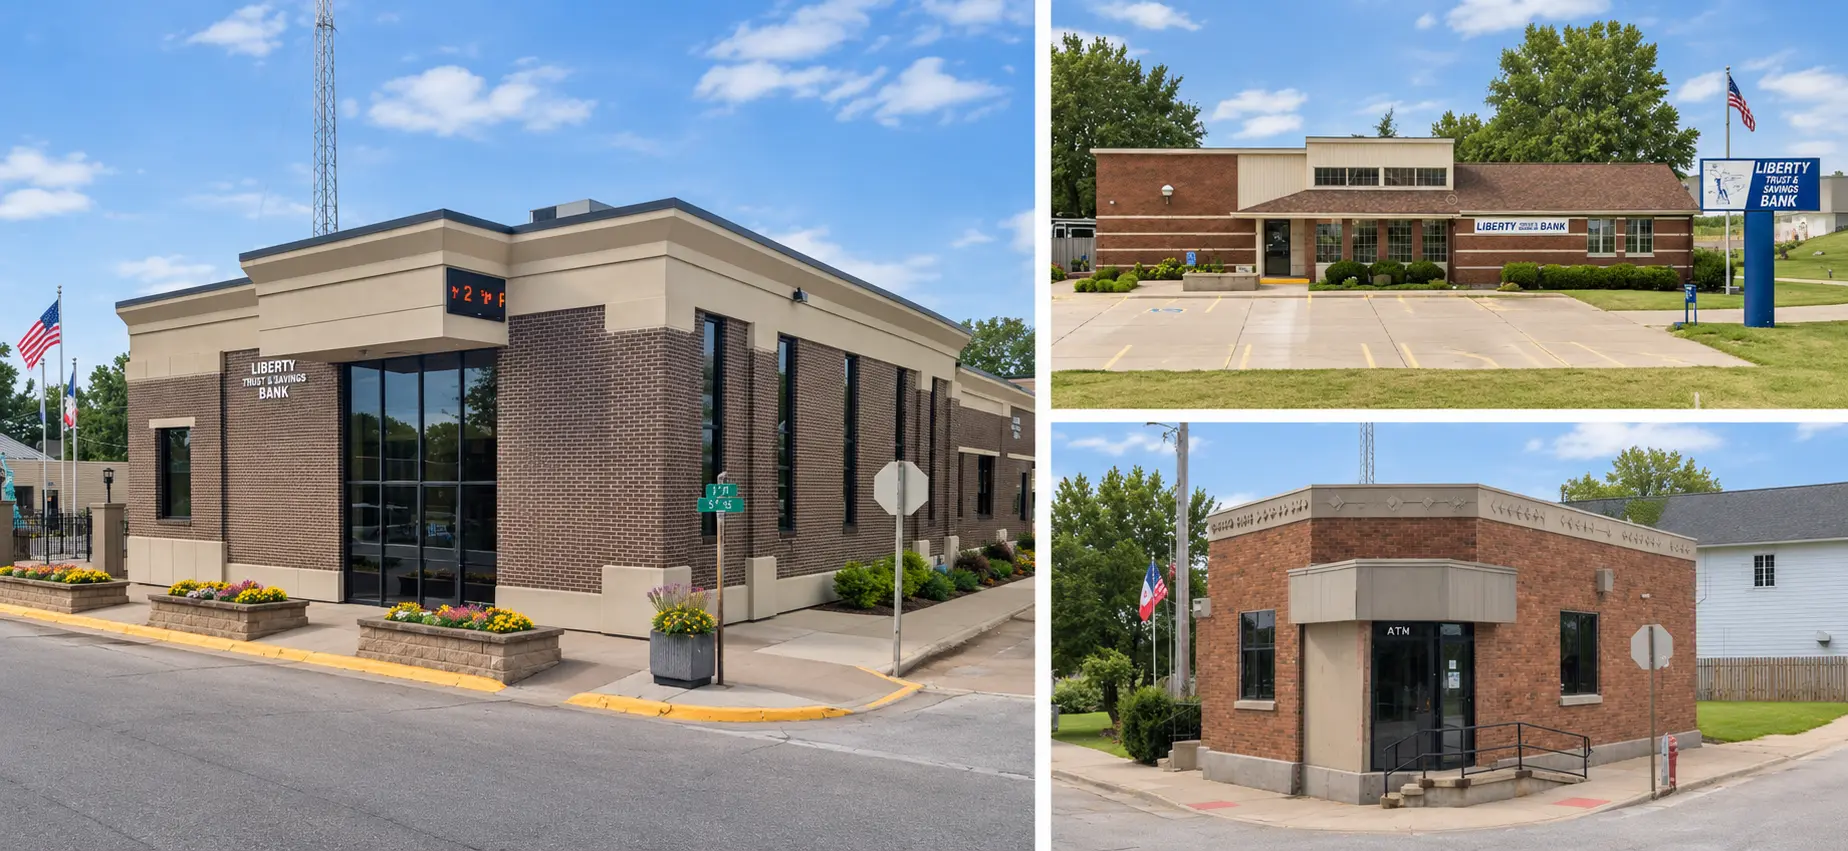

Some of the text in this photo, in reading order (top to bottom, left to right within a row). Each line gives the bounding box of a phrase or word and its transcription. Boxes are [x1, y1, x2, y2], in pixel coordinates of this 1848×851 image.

[1755, 162, 1810, 174] LIBERTY
[1766, 176, 1798, 184] TRUST &
[1763, 185, 1799, 193] SAVINGS
[1760, 194, 1797, 207] BANK
[1476, 222, 1516, 231] LIBERTY
[1540, 222, 1565, 231] BANK
[251, 359, 296, 375] LIBERTY
[259, 385, 289, 399] BANK
[1387, 626, 1410, 635] ATM
